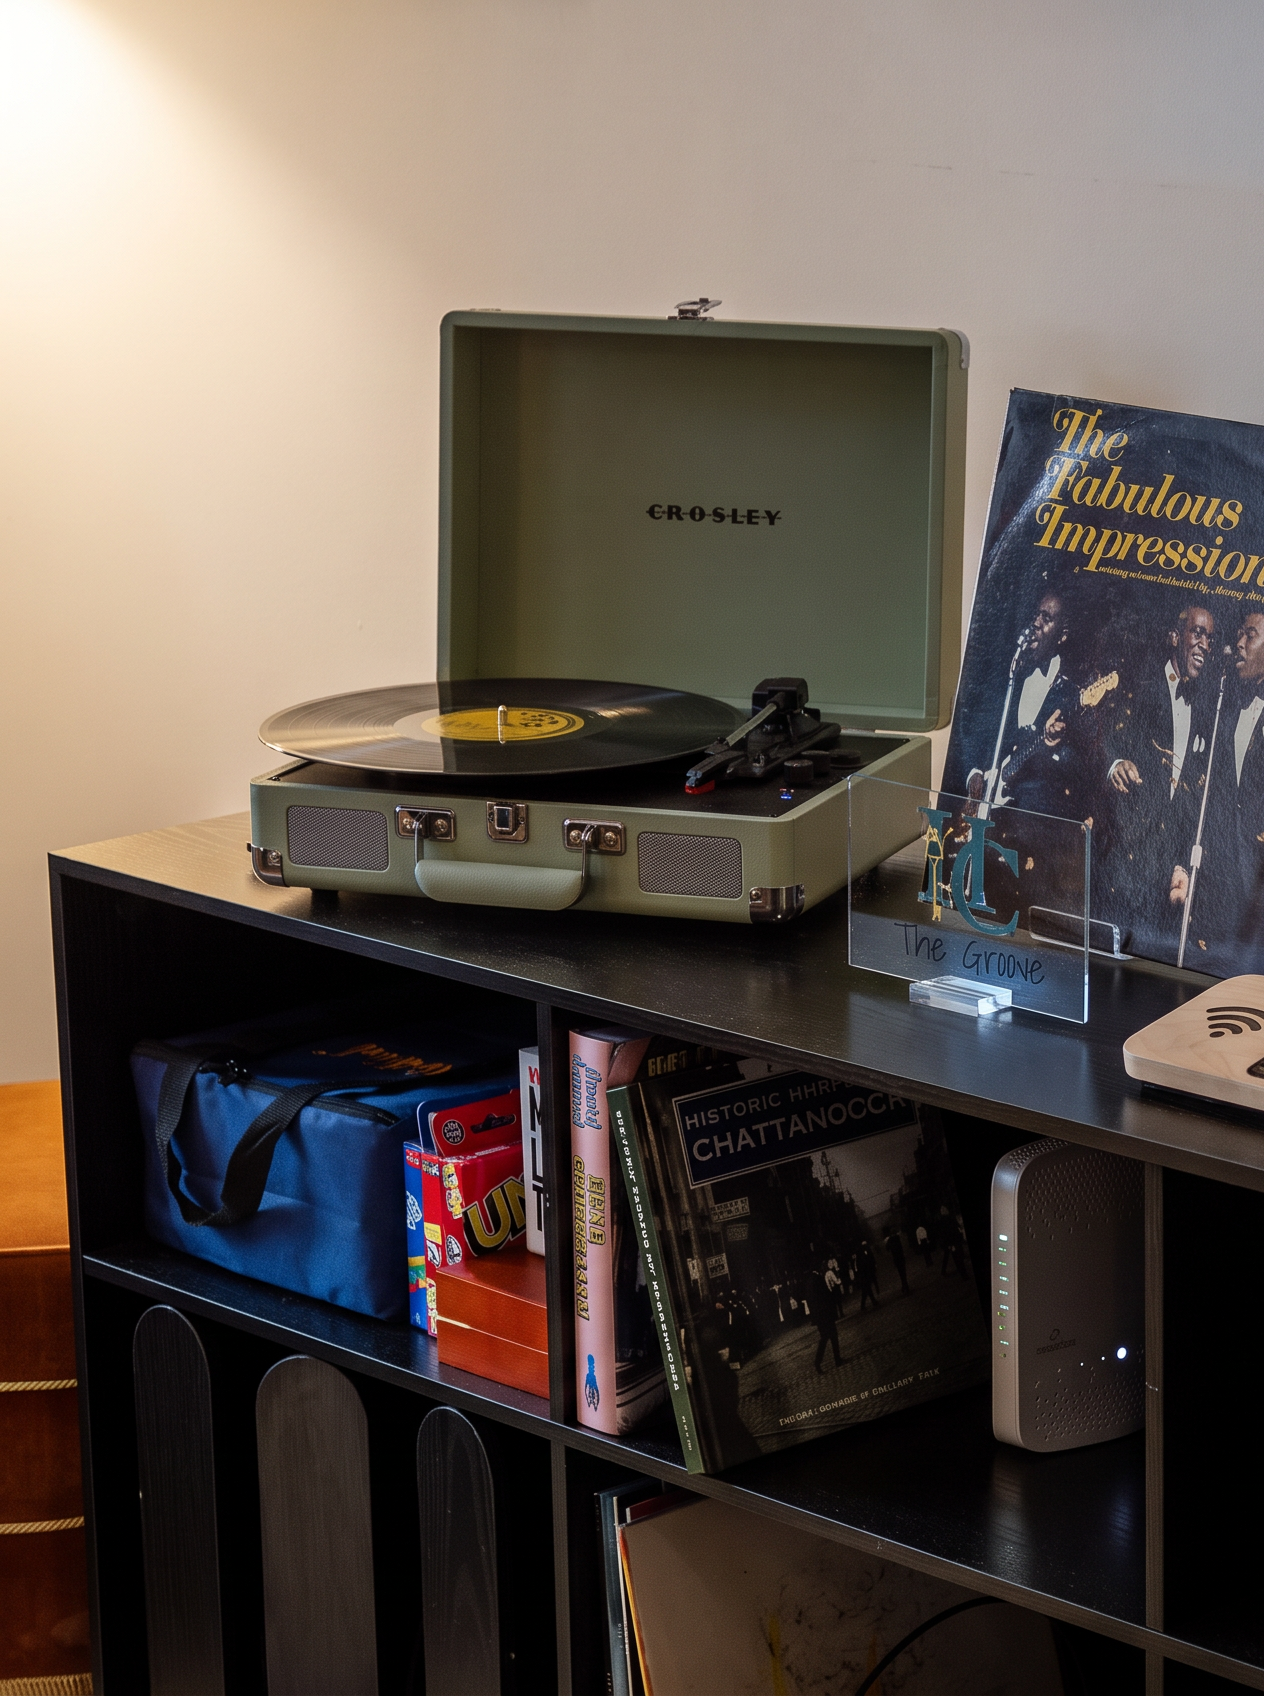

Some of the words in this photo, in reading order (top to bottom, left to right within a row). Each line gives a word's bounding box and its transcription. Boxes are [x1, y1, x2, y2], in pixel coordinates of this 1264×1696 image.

[1053, 408, 1128, 461] The
[646, 503, 782, 526] CROSLEY
[1045, 456, 1243, 531] Fabulous
[894, 922, 947, 962] The
[962, 941, 1046, 985] Groove
[684, 1092, 782, 1130] HISTORIC
